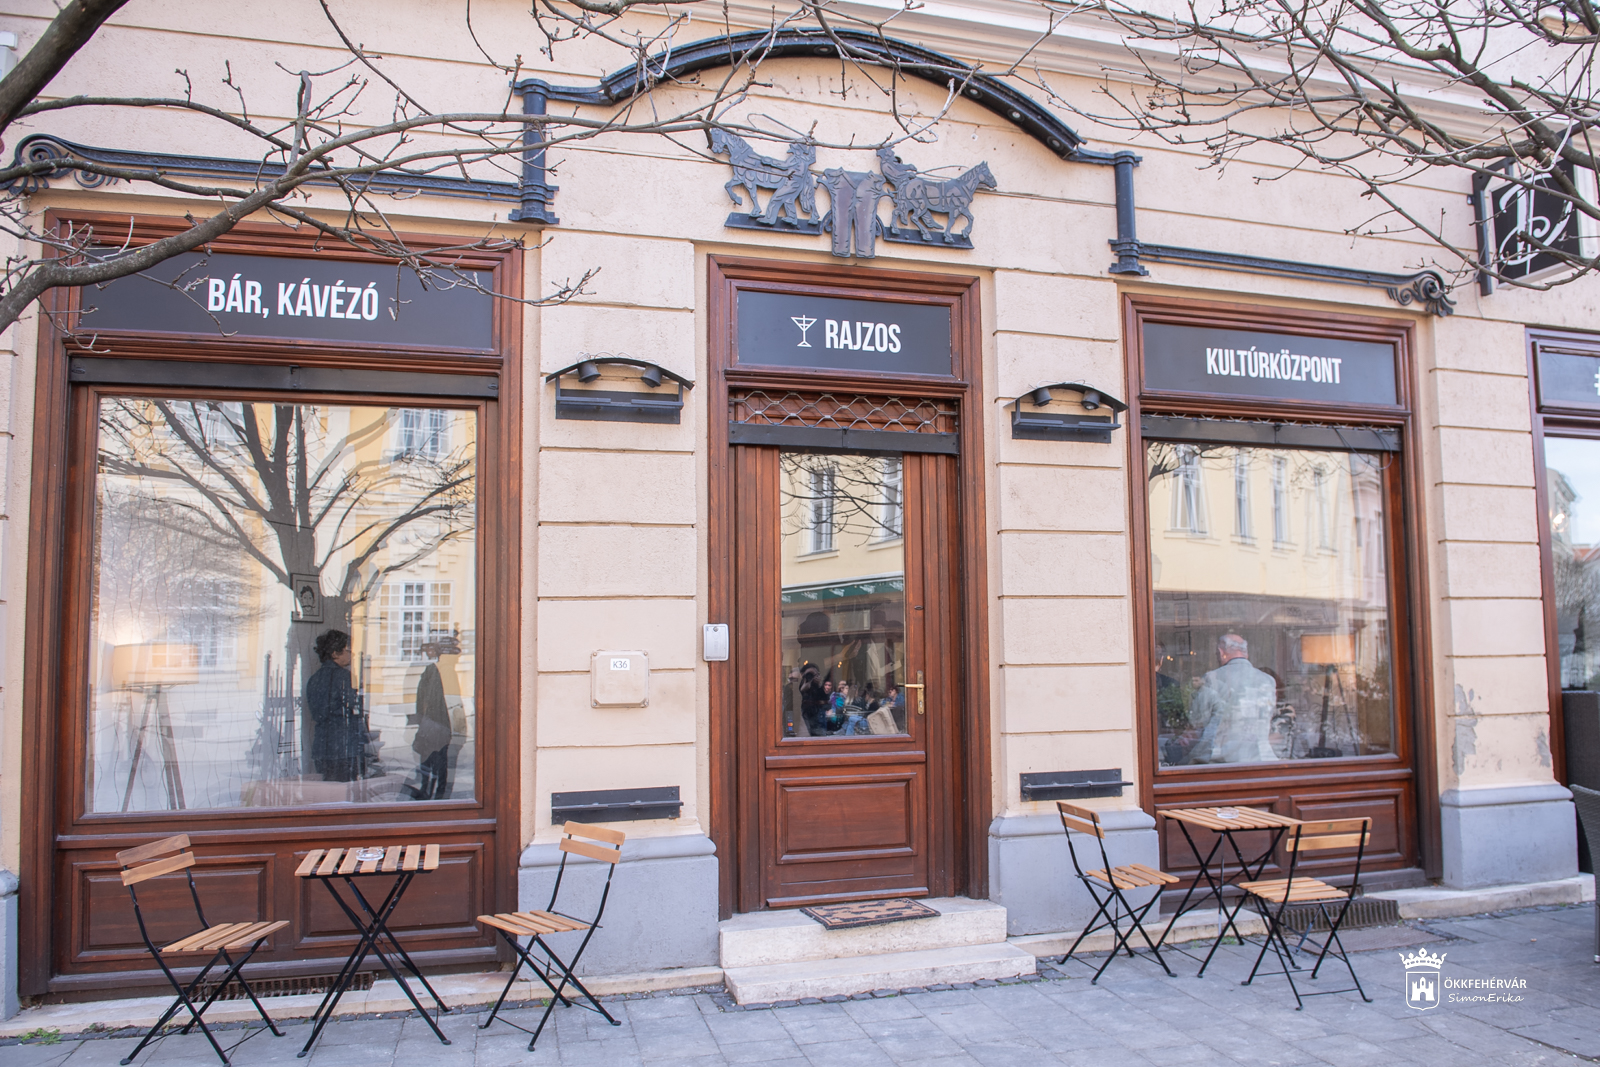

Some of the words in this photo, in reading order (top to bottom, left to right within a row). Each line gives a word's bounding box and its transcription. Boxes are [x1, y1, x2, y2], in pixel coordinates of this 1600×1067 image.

[207, 273, 270, 319] BÁR,
[277, 277, 380, 322] KÁVÉZÓ
[825, 319, 902, 354] RAJZOS
[1206, 346, 1343, 385] KULTÚRKÖZPONT
[612, 660, 628, 669] K36
